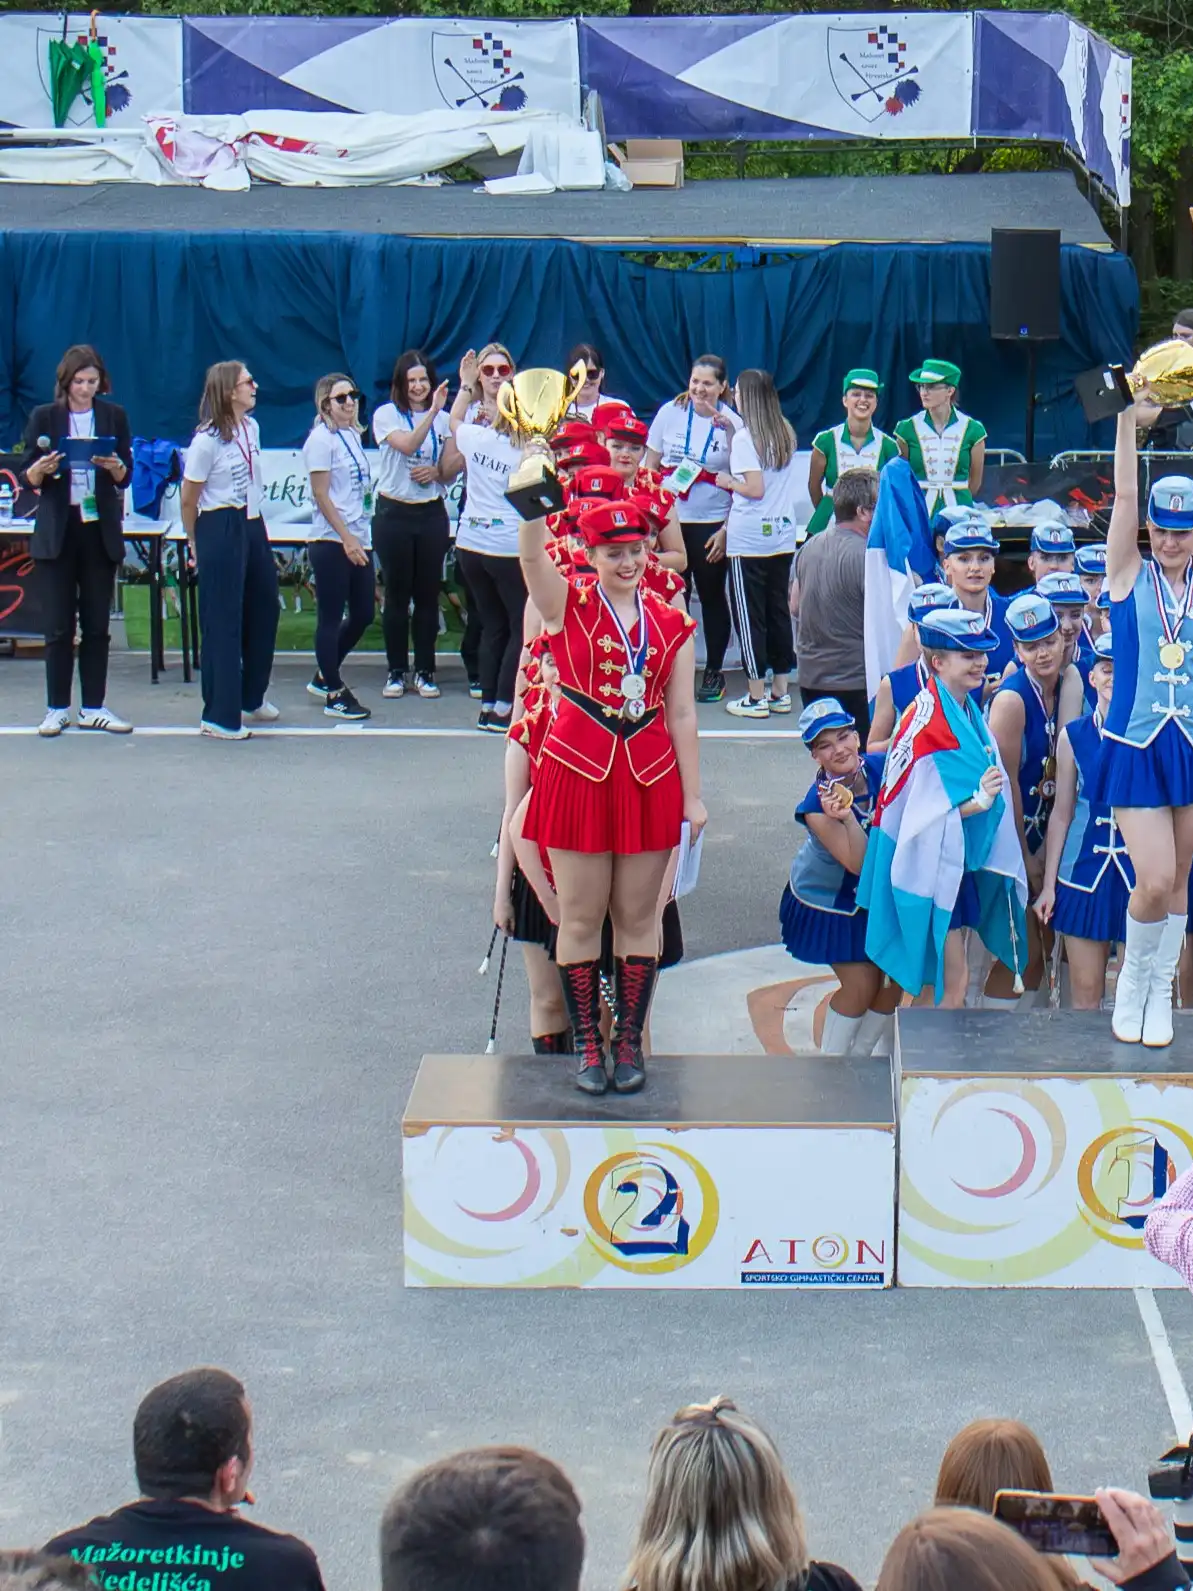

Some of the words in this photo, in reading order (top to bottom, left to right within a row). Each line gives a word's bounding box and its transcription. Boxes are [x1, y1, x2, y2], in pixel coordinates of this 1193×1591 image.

[472, 452, 511, 474] STAFF
[609, 1161, 690, 1256] 2
[741, 1232, 884, 1269] ATON
[744, 1274, 787, 1282] SPORTSKO
[846, 1274, 880, 1282] CENTAR
[70, 1541, 245, 1572] Mažoretkinje
